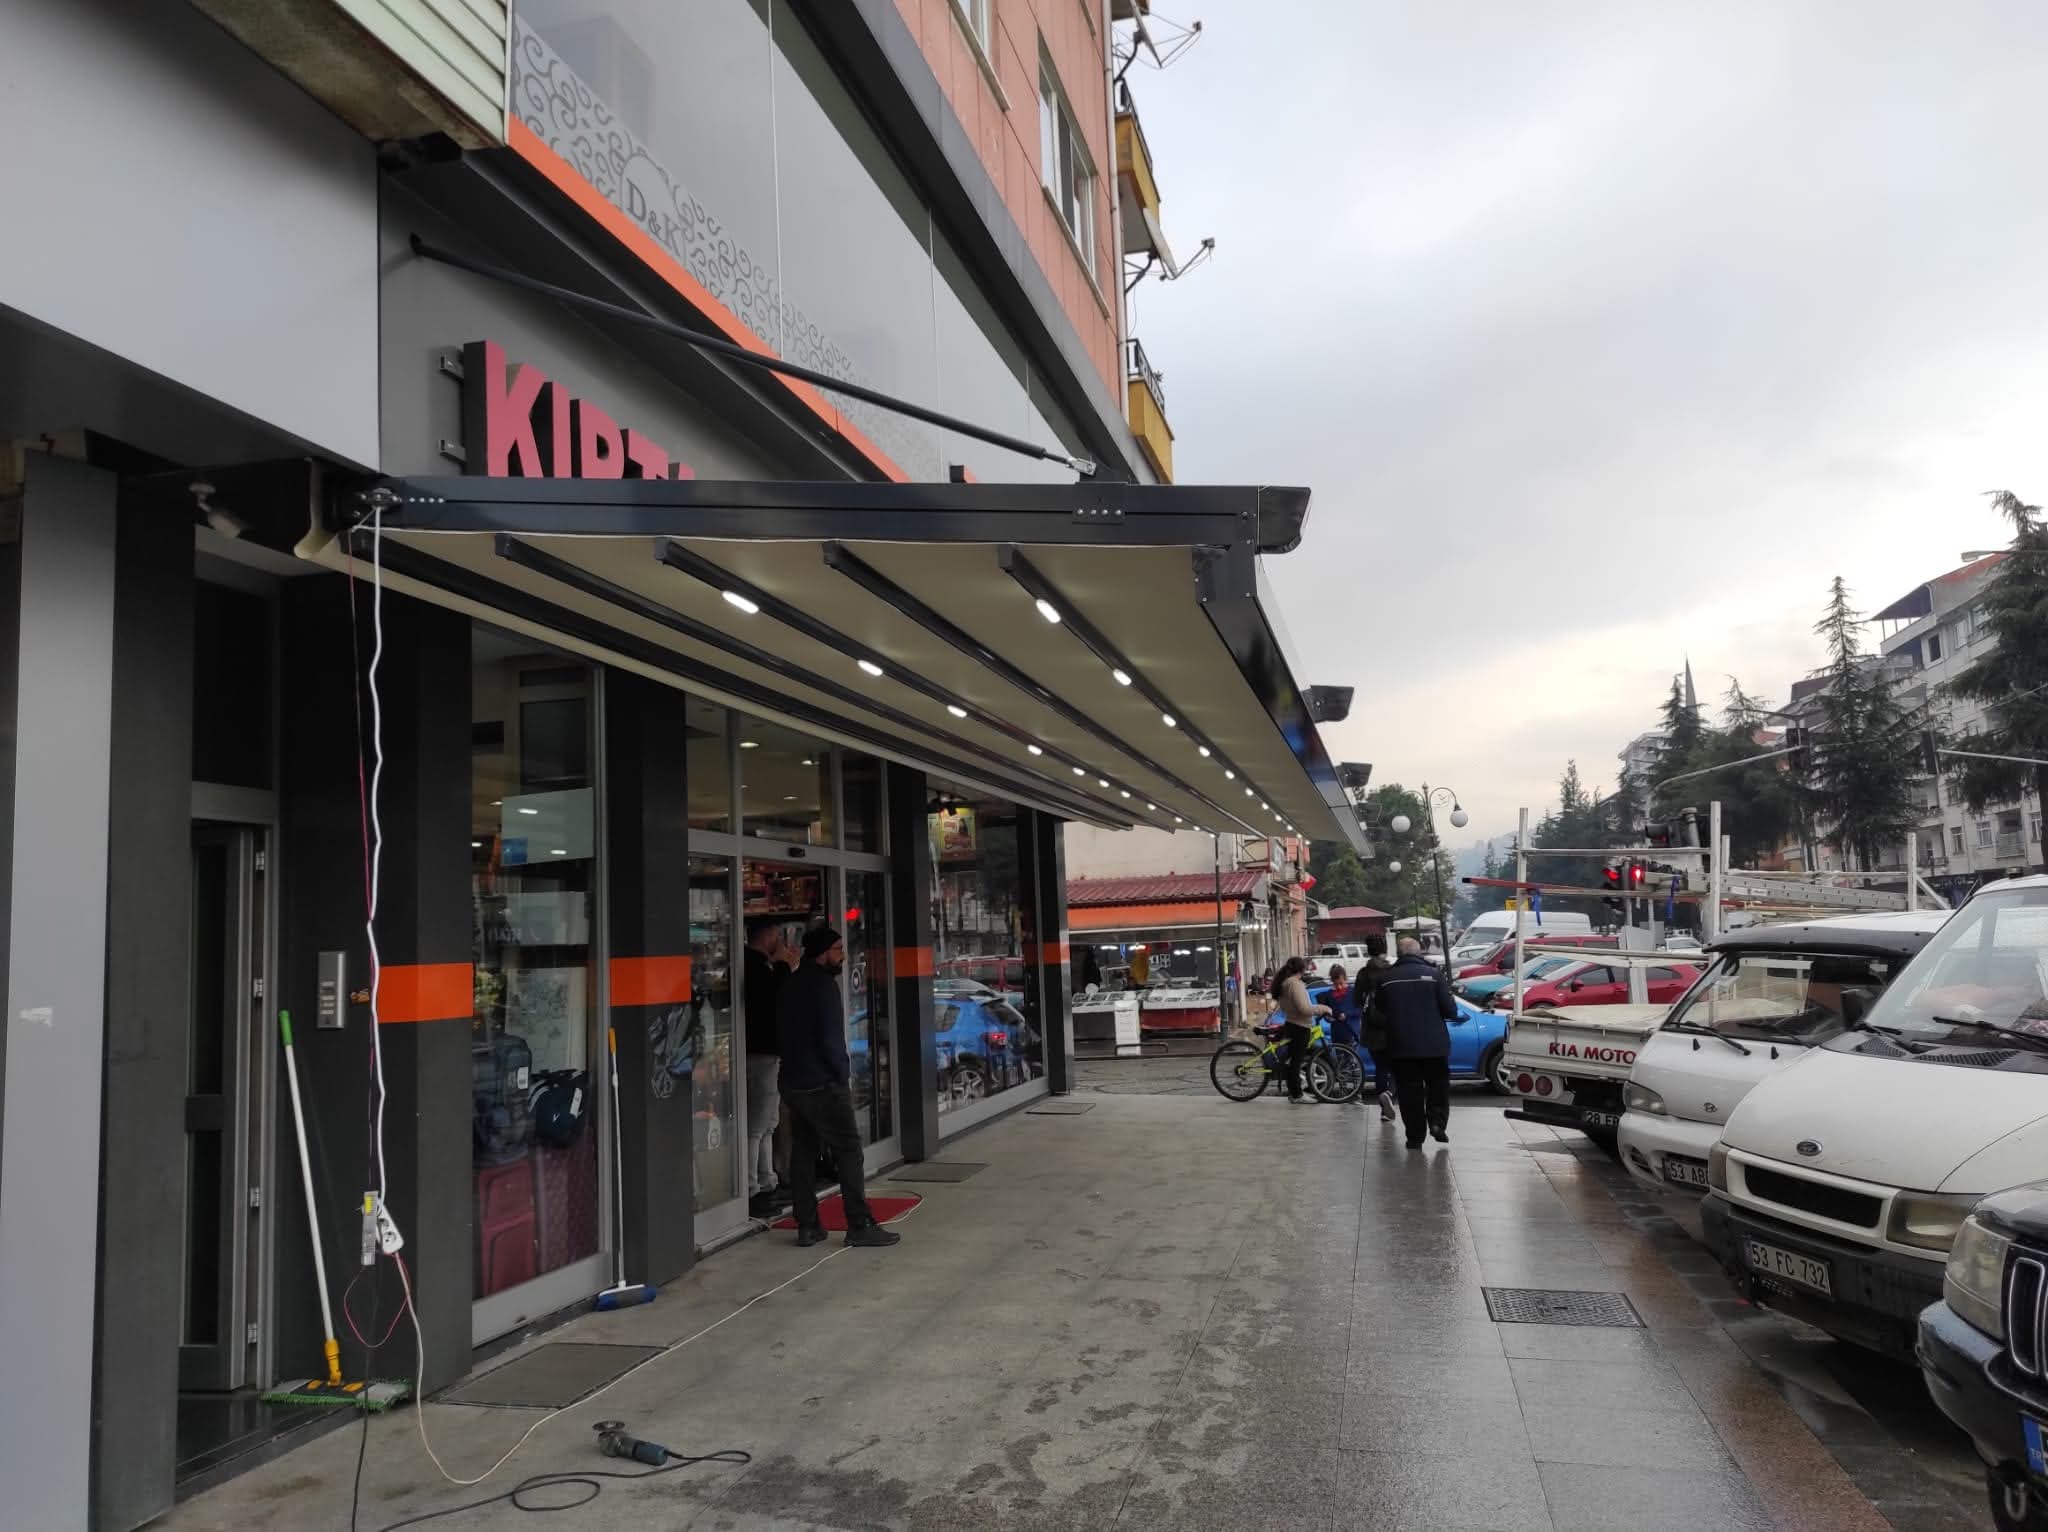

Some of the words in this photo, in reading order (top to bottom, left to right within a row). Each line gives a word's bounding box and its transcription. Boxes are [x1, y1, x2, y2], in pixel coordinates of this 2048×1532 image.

[626, 177, 680, 256] D&K
[1548, 1042, 1578, 1058] KIA
[1671, 1162, 1684, 1179] 53
[1752, 1244, 1768, 1267] 53
[1776, 1251, 1794, 1275] FC
[1800, 1259, 1827, 1288] 732
